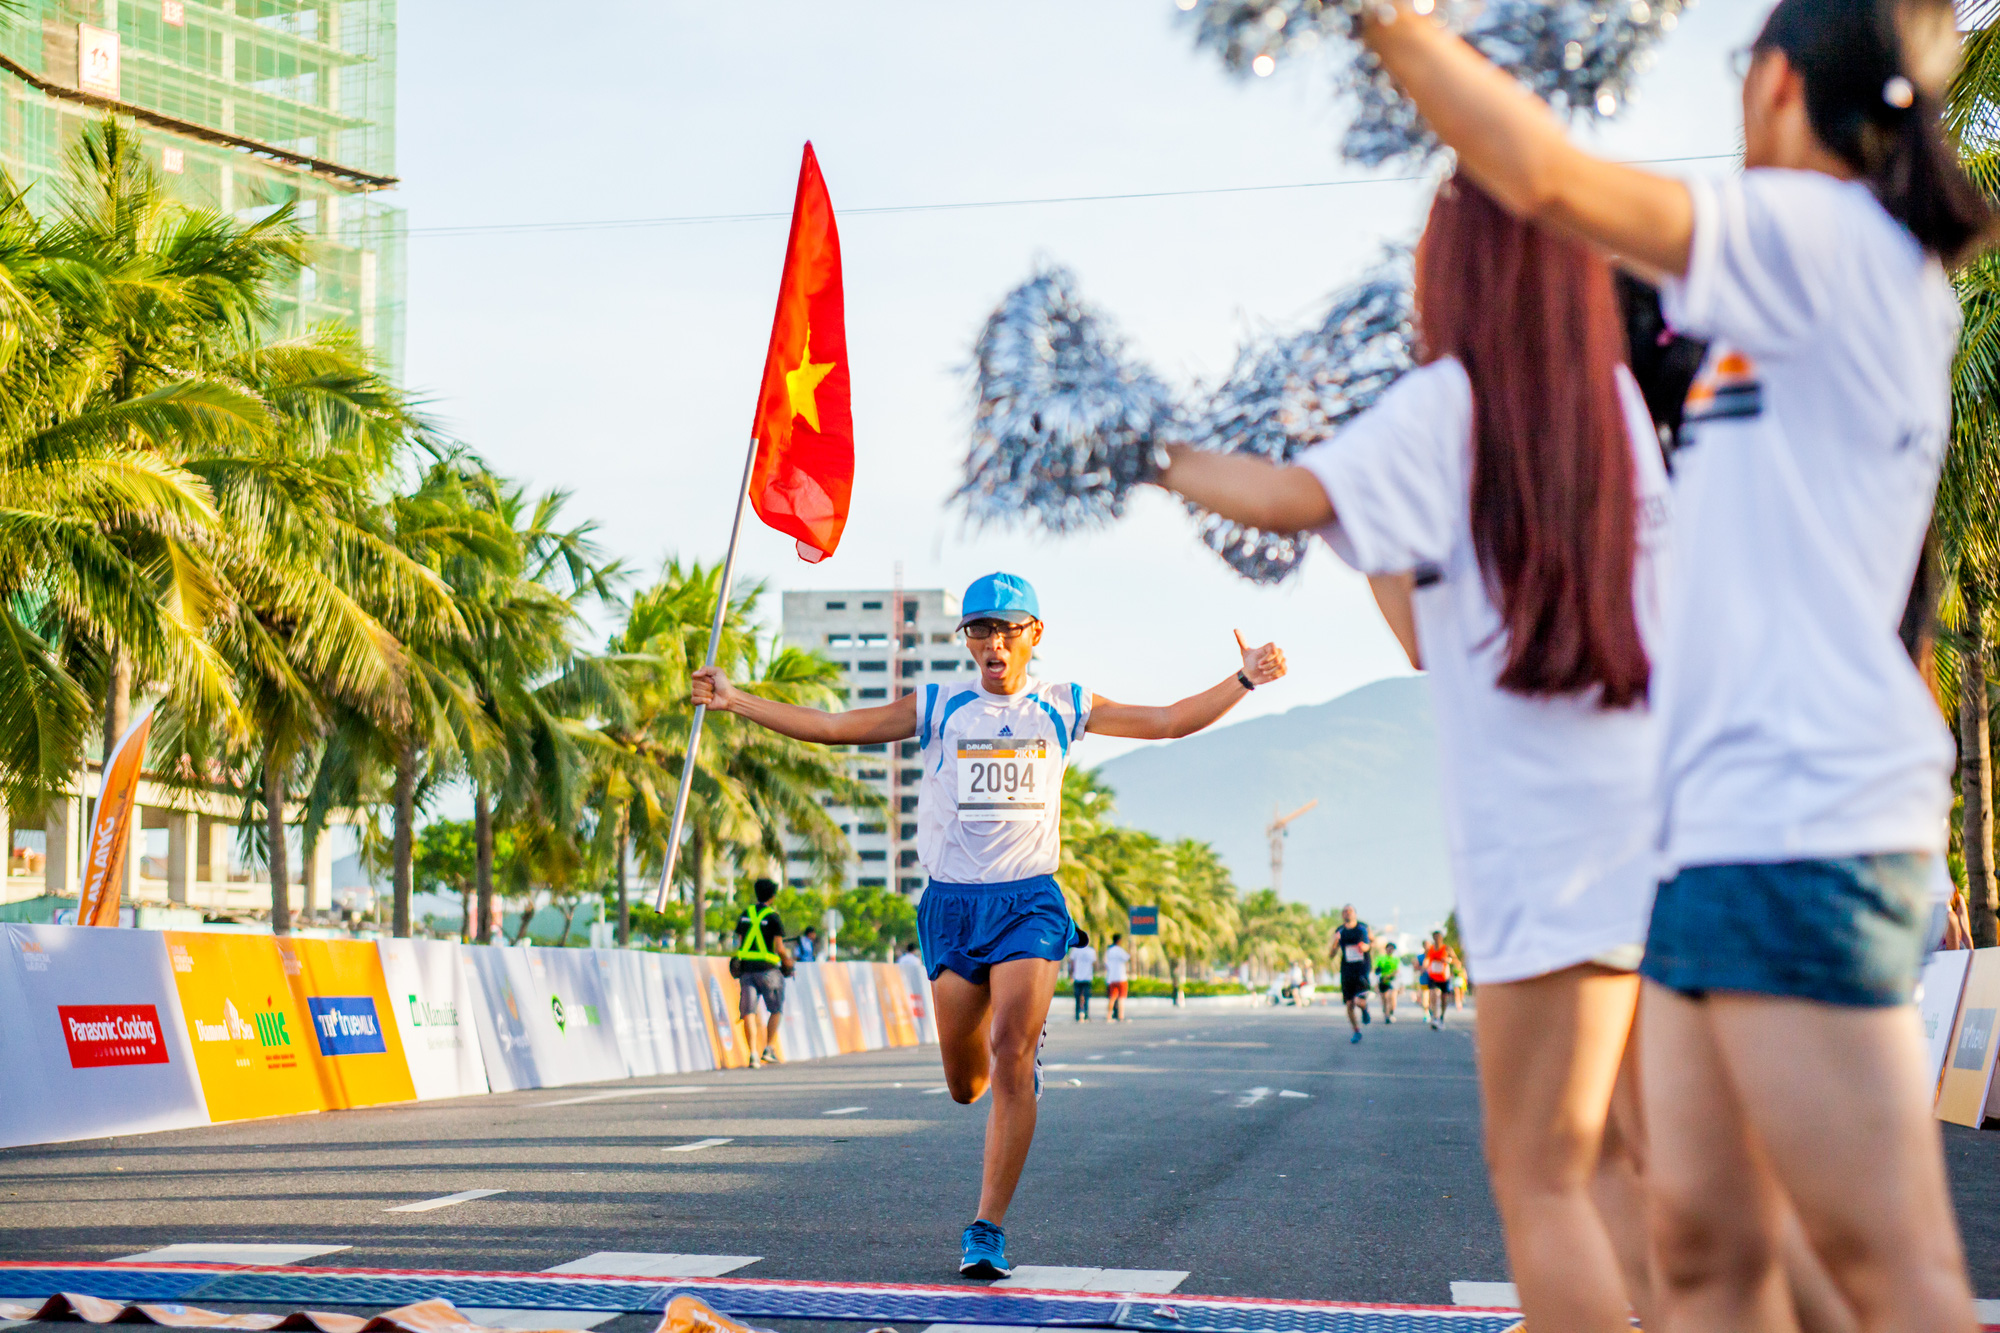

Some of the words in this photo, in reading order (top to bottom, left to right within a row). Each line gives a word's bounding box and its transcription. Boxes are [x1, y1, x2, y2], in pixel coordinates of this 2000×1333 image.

[970, 762, 1036, 793] 2094
[420, 1001, 460, 1026] Manulife
[68, 1015, 119, 1042] Panasonic
[116, 1014, 157, 1045] Cooking
[195, 1019, 231, 1042] Diamond
